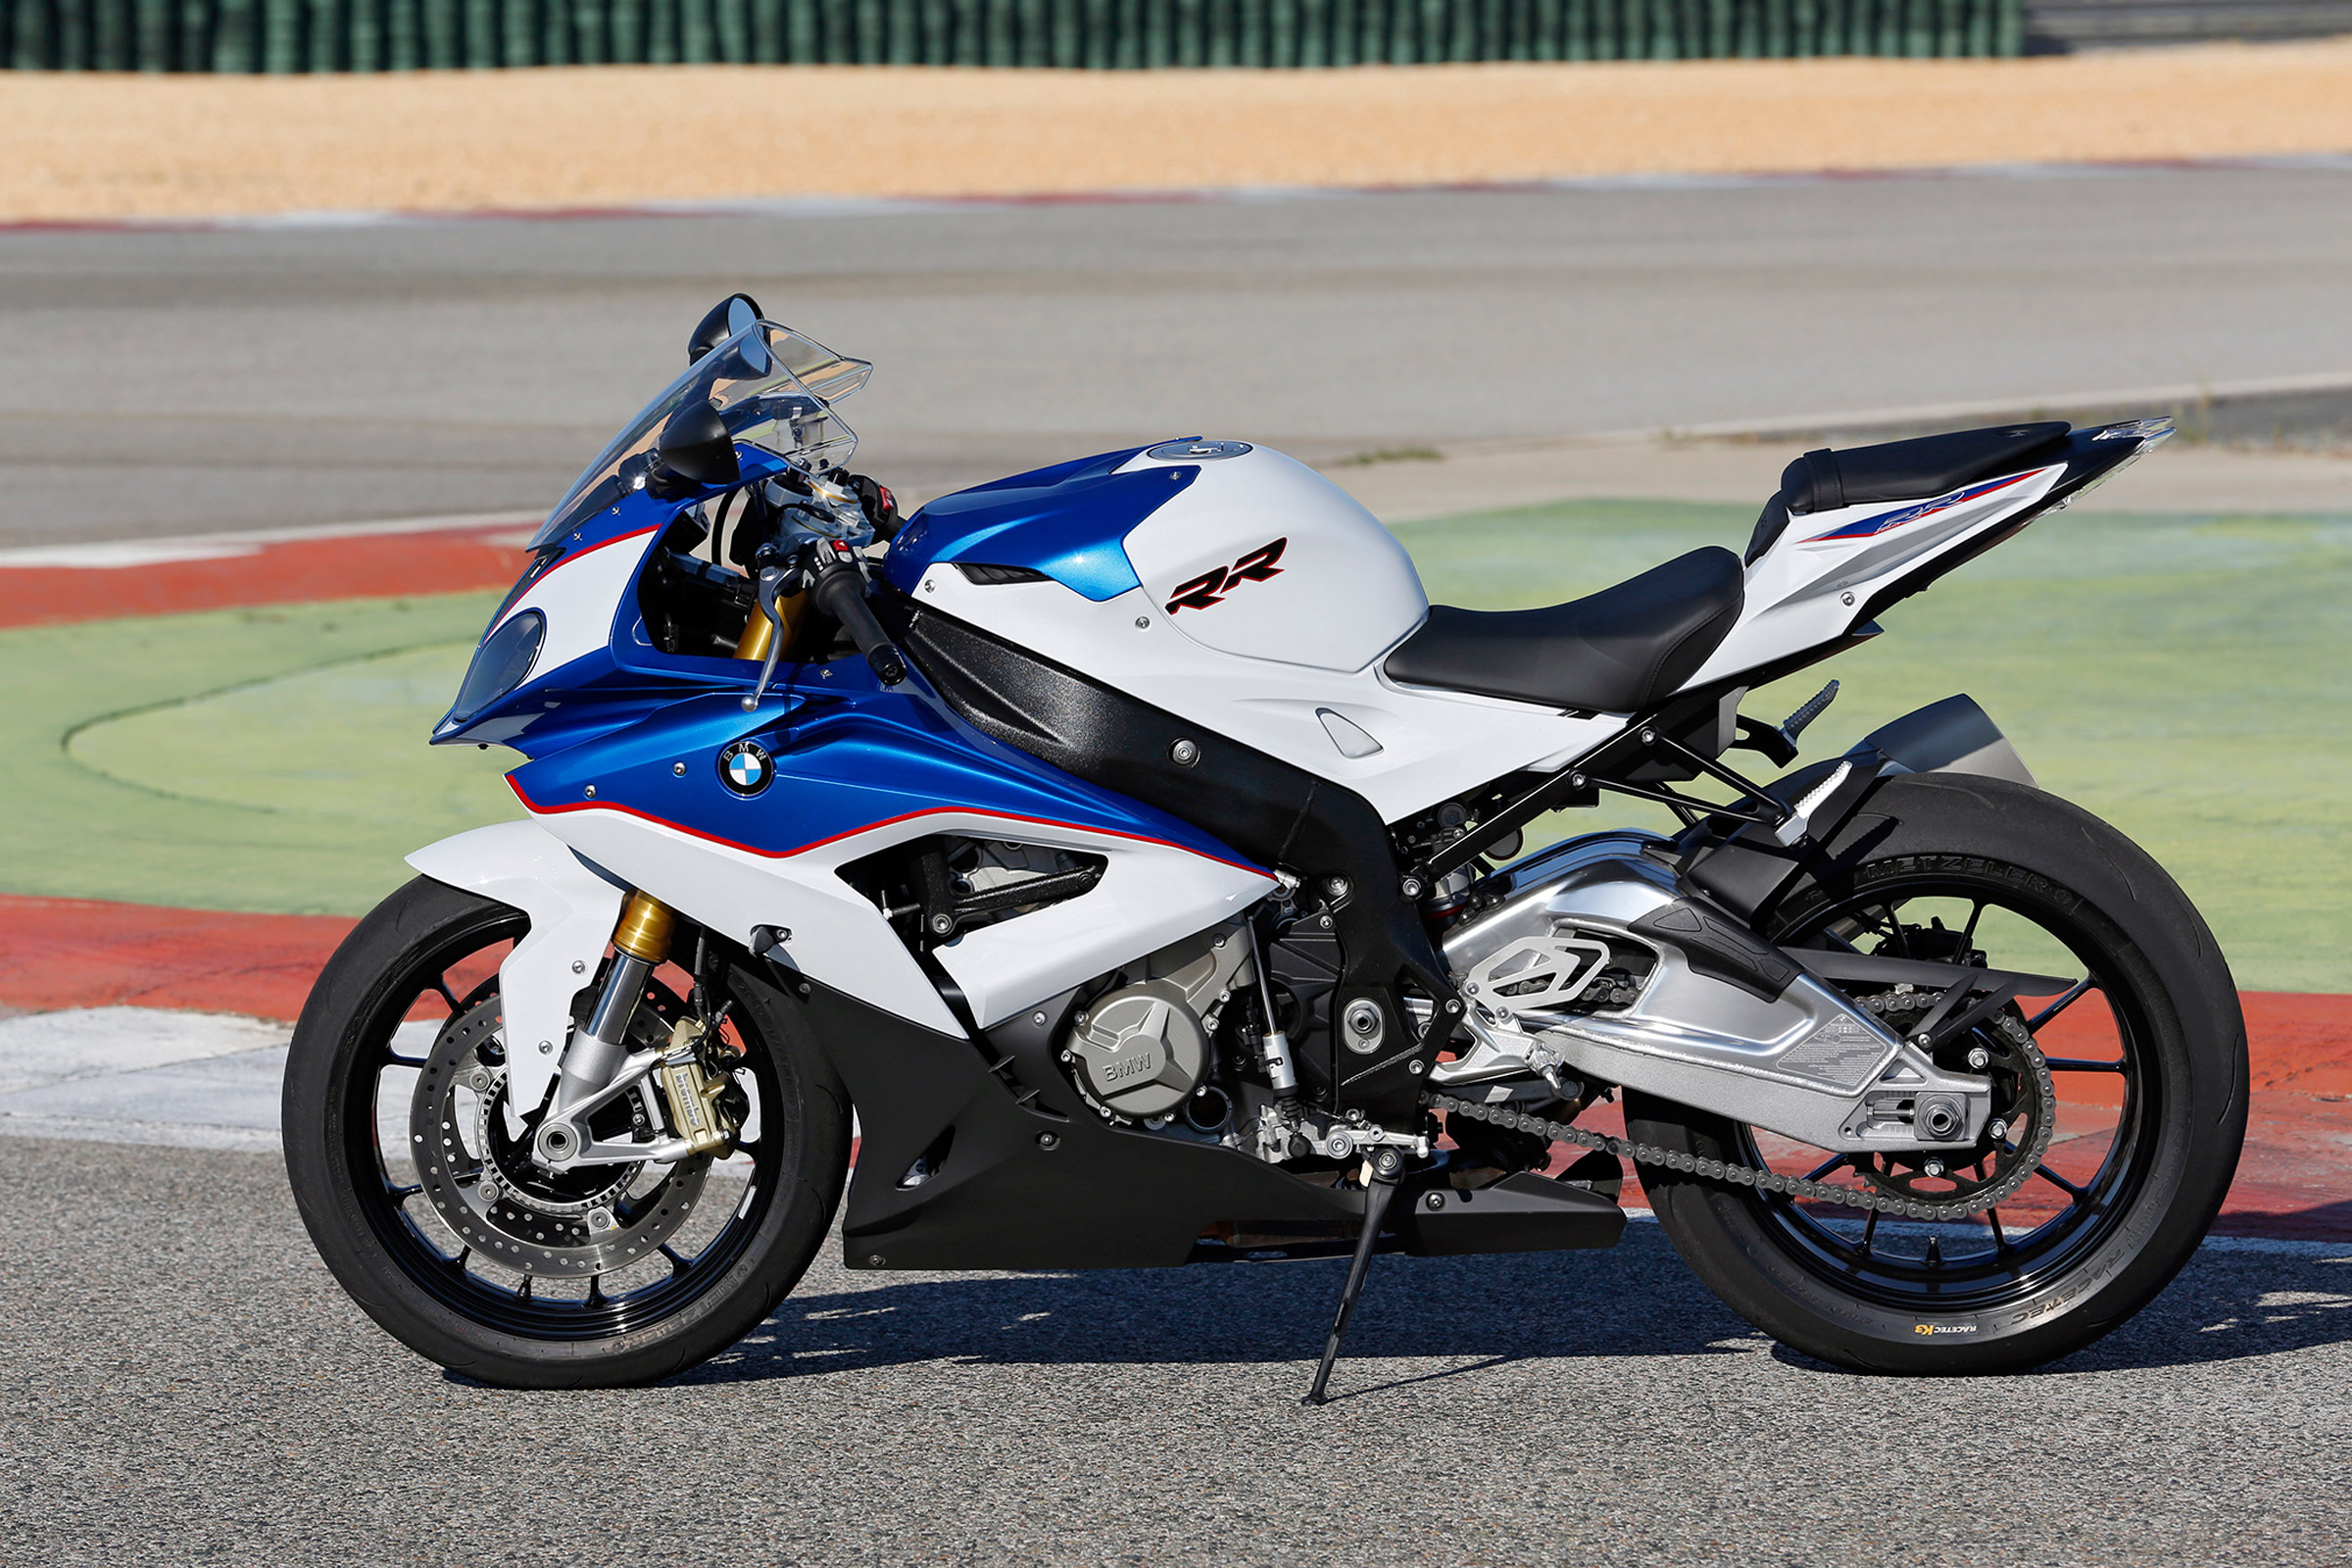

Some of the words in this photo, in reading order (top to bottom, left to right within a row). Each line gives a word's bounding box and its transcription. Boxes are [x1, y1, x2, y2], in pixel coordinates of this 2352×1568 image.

[1164, 536, 1288, 615] RR
[723, 743, 766, 761] BMW
[1866, 855, 2048, 894] METZELER
[1102, 1053, 1152, 1083] BMW
[675, 1071, 700, 1127] brembo
